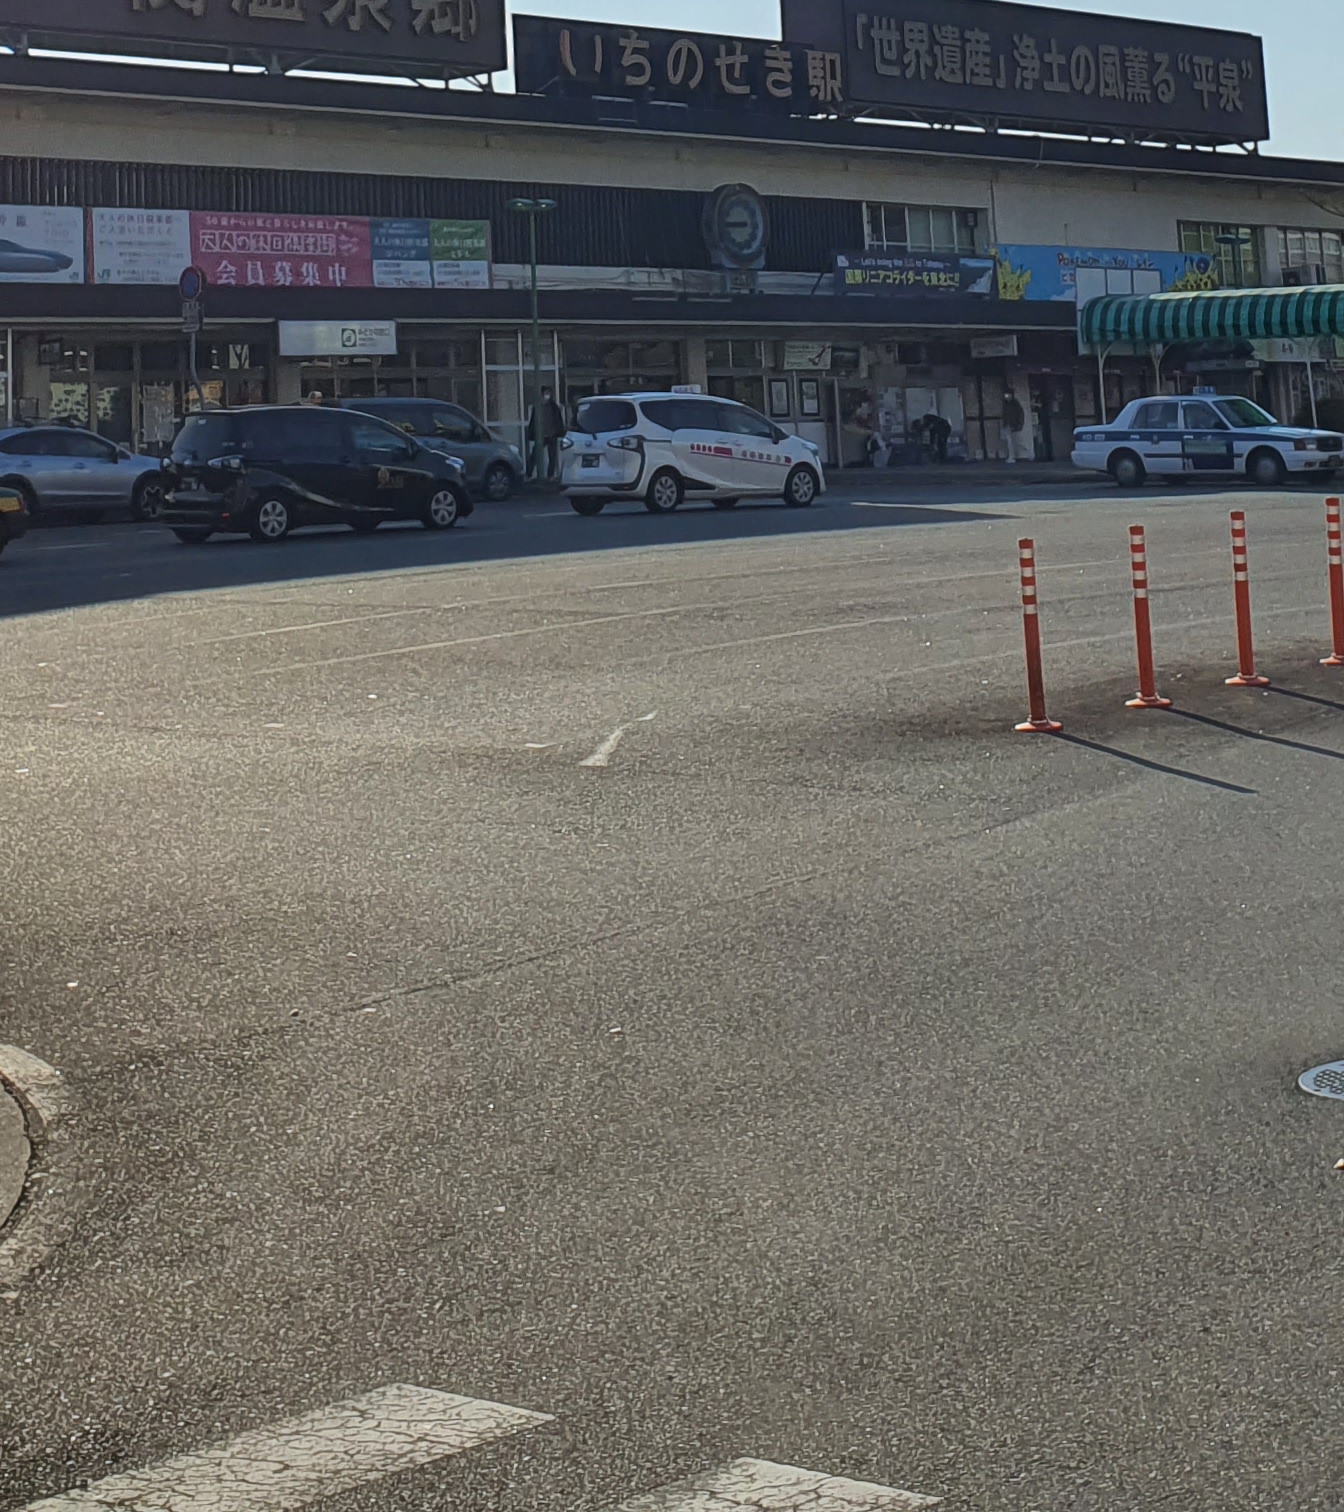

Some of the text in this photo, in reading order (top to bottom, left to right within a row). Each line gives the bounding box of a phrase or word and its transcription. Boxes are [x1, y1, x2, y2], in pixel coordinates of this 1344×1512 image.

[559, 28, 843, 103] いちのせき駅
[216, 259, 348, 287] 会員募集中
